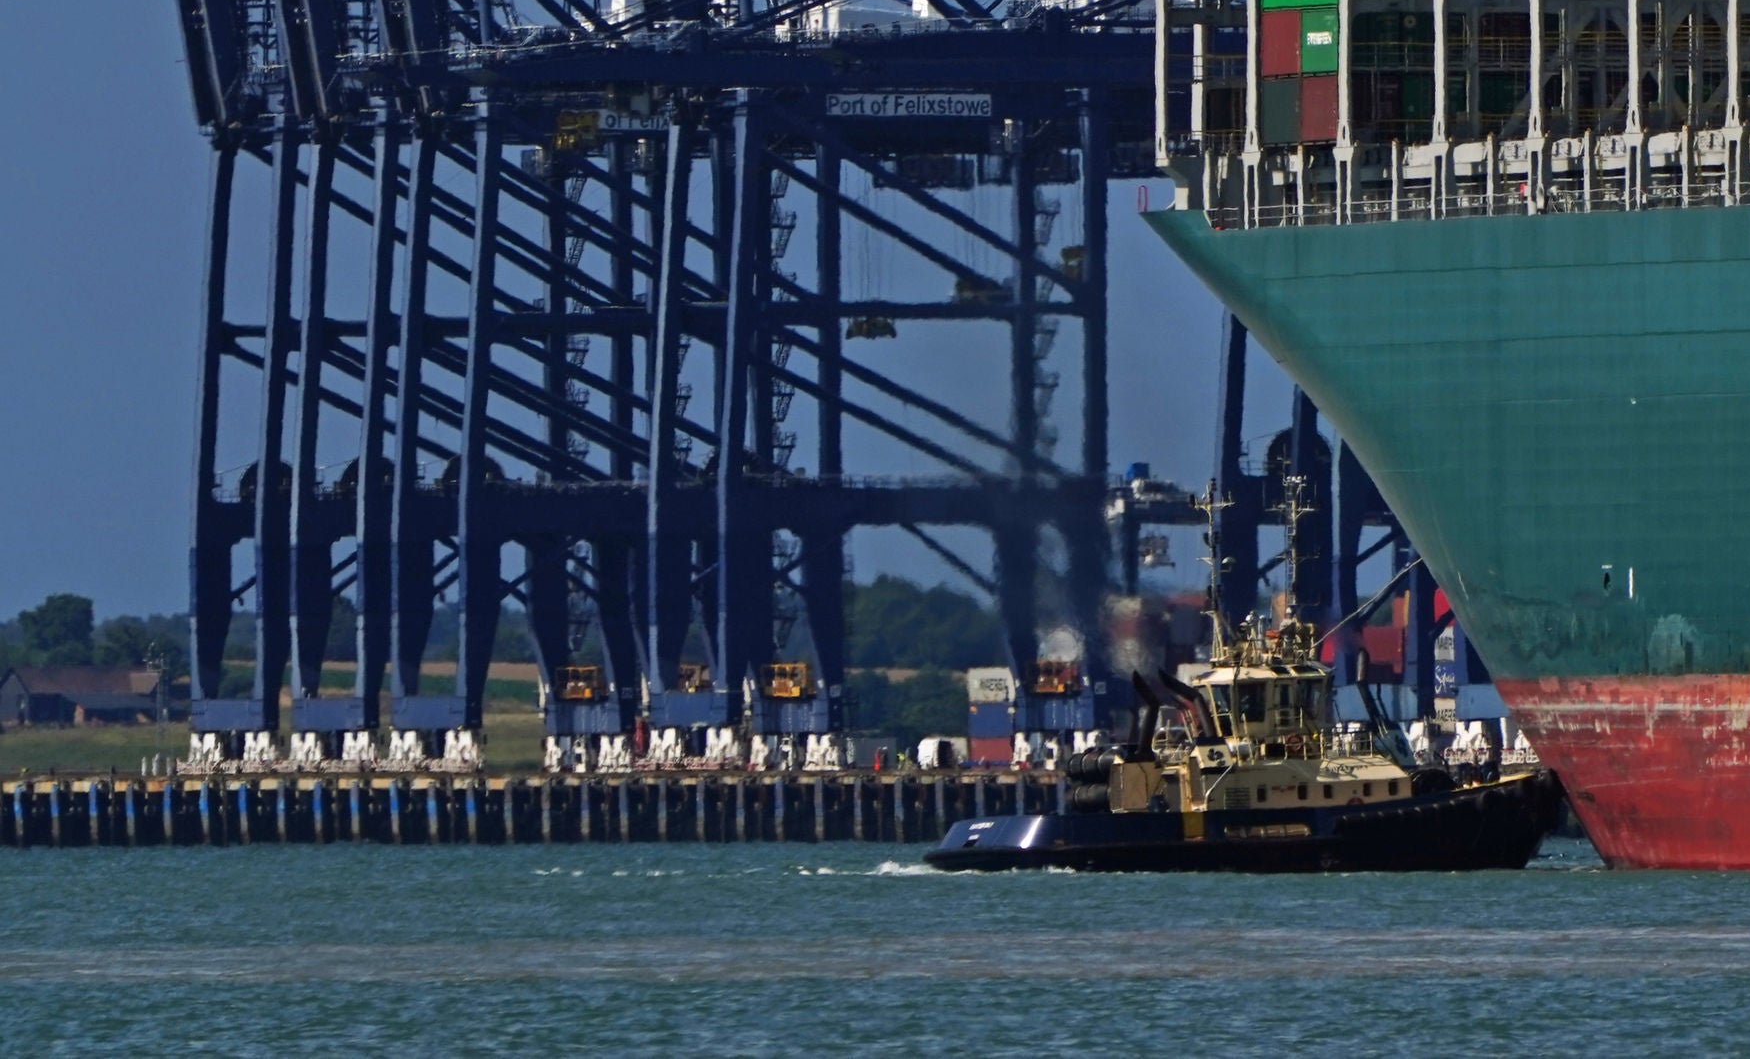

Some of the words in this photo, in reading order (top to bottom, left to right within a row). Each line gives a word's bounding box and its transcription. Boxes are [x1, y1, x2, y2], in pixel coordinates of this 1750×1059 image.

[827, 94, 865, 115] Port
[870, 95, 889, 115] of
[894, 95, 991, 116] Felixstowe
